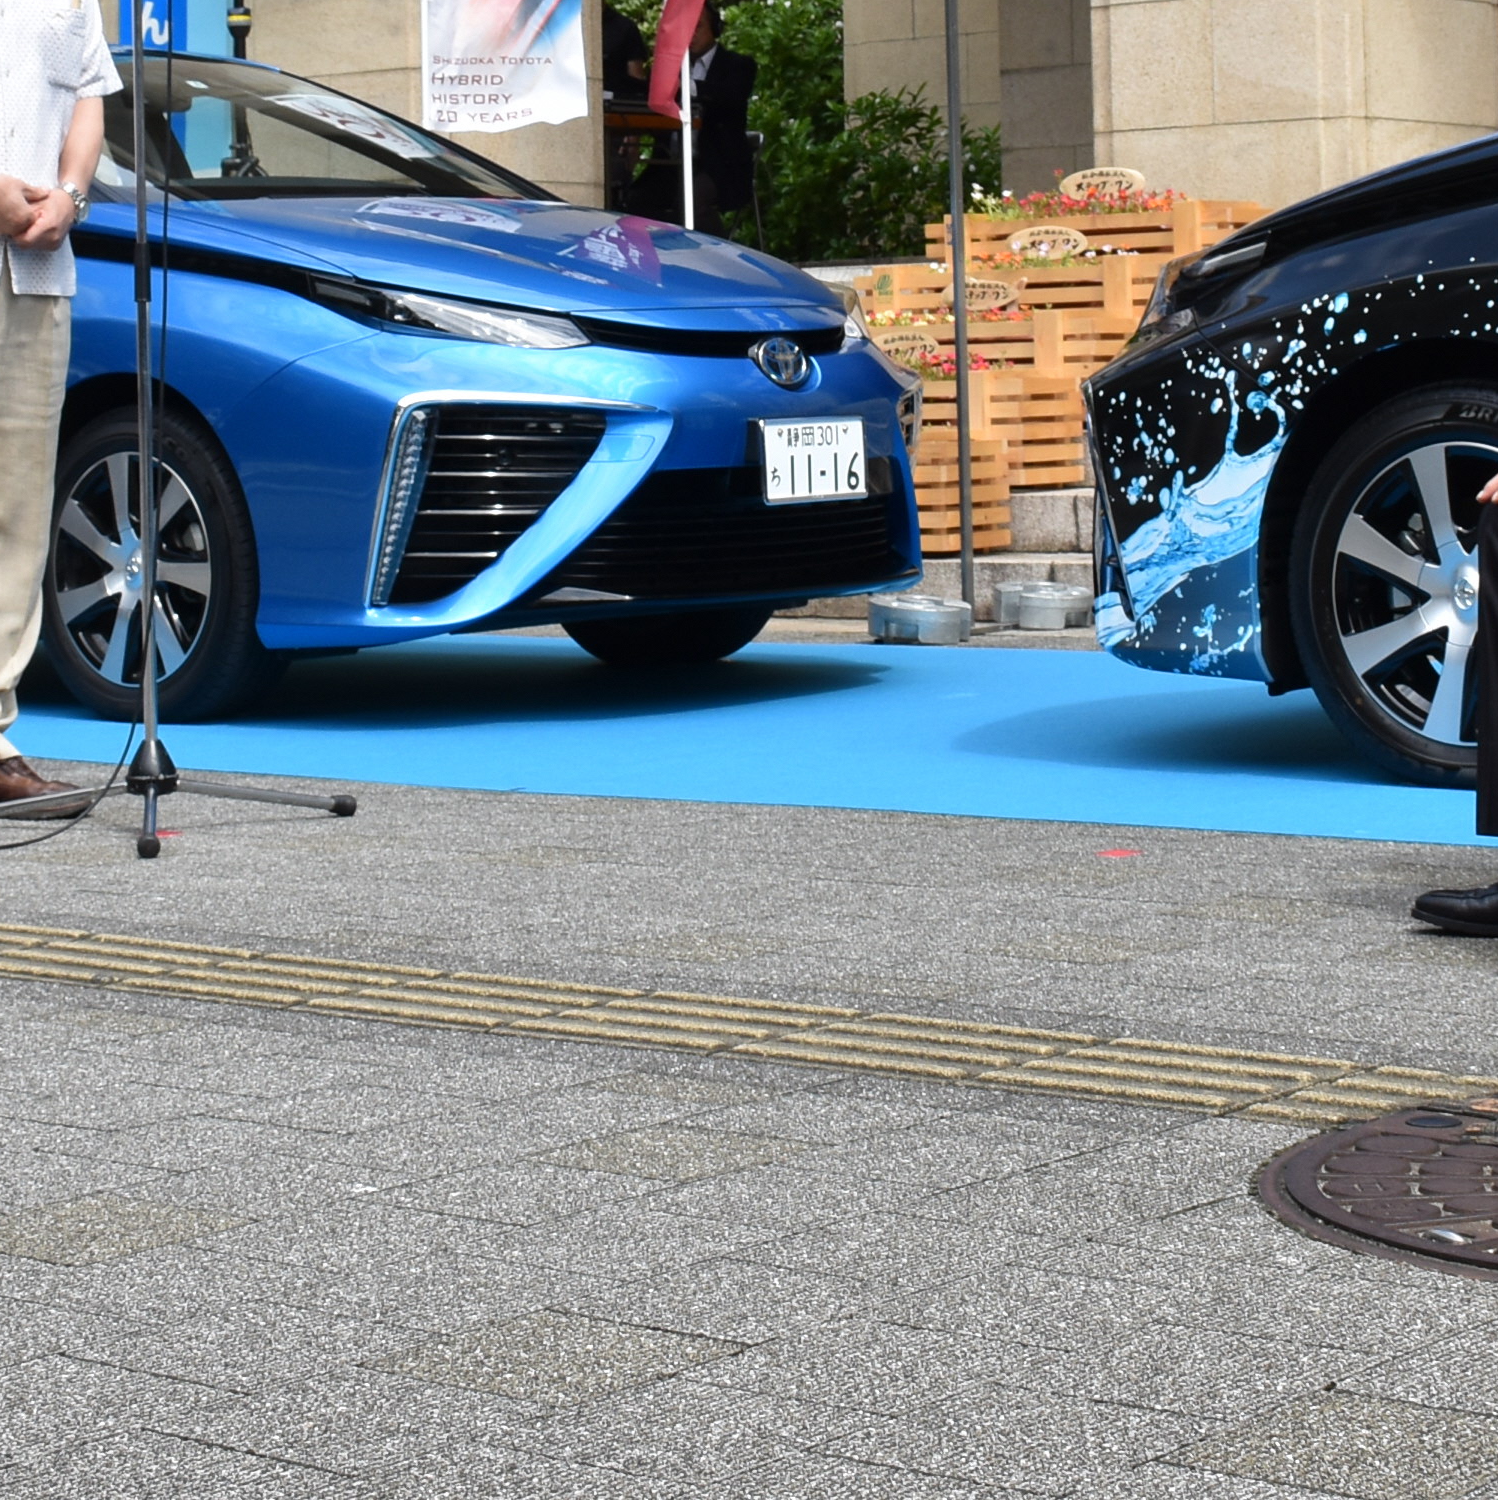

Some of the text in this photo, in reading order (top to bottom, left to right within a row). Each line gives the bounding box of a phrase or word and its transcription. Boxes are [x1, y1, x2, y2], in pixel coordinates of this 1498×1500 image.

[431, 72, 504, 86] HYBRID
[432, 93, 513, 106] HISTORY
[436, 107, 533, 124] 20 YEARS
[786, 425, 840, 448] 静岡 301
[770, 466, 782, 488] ち
